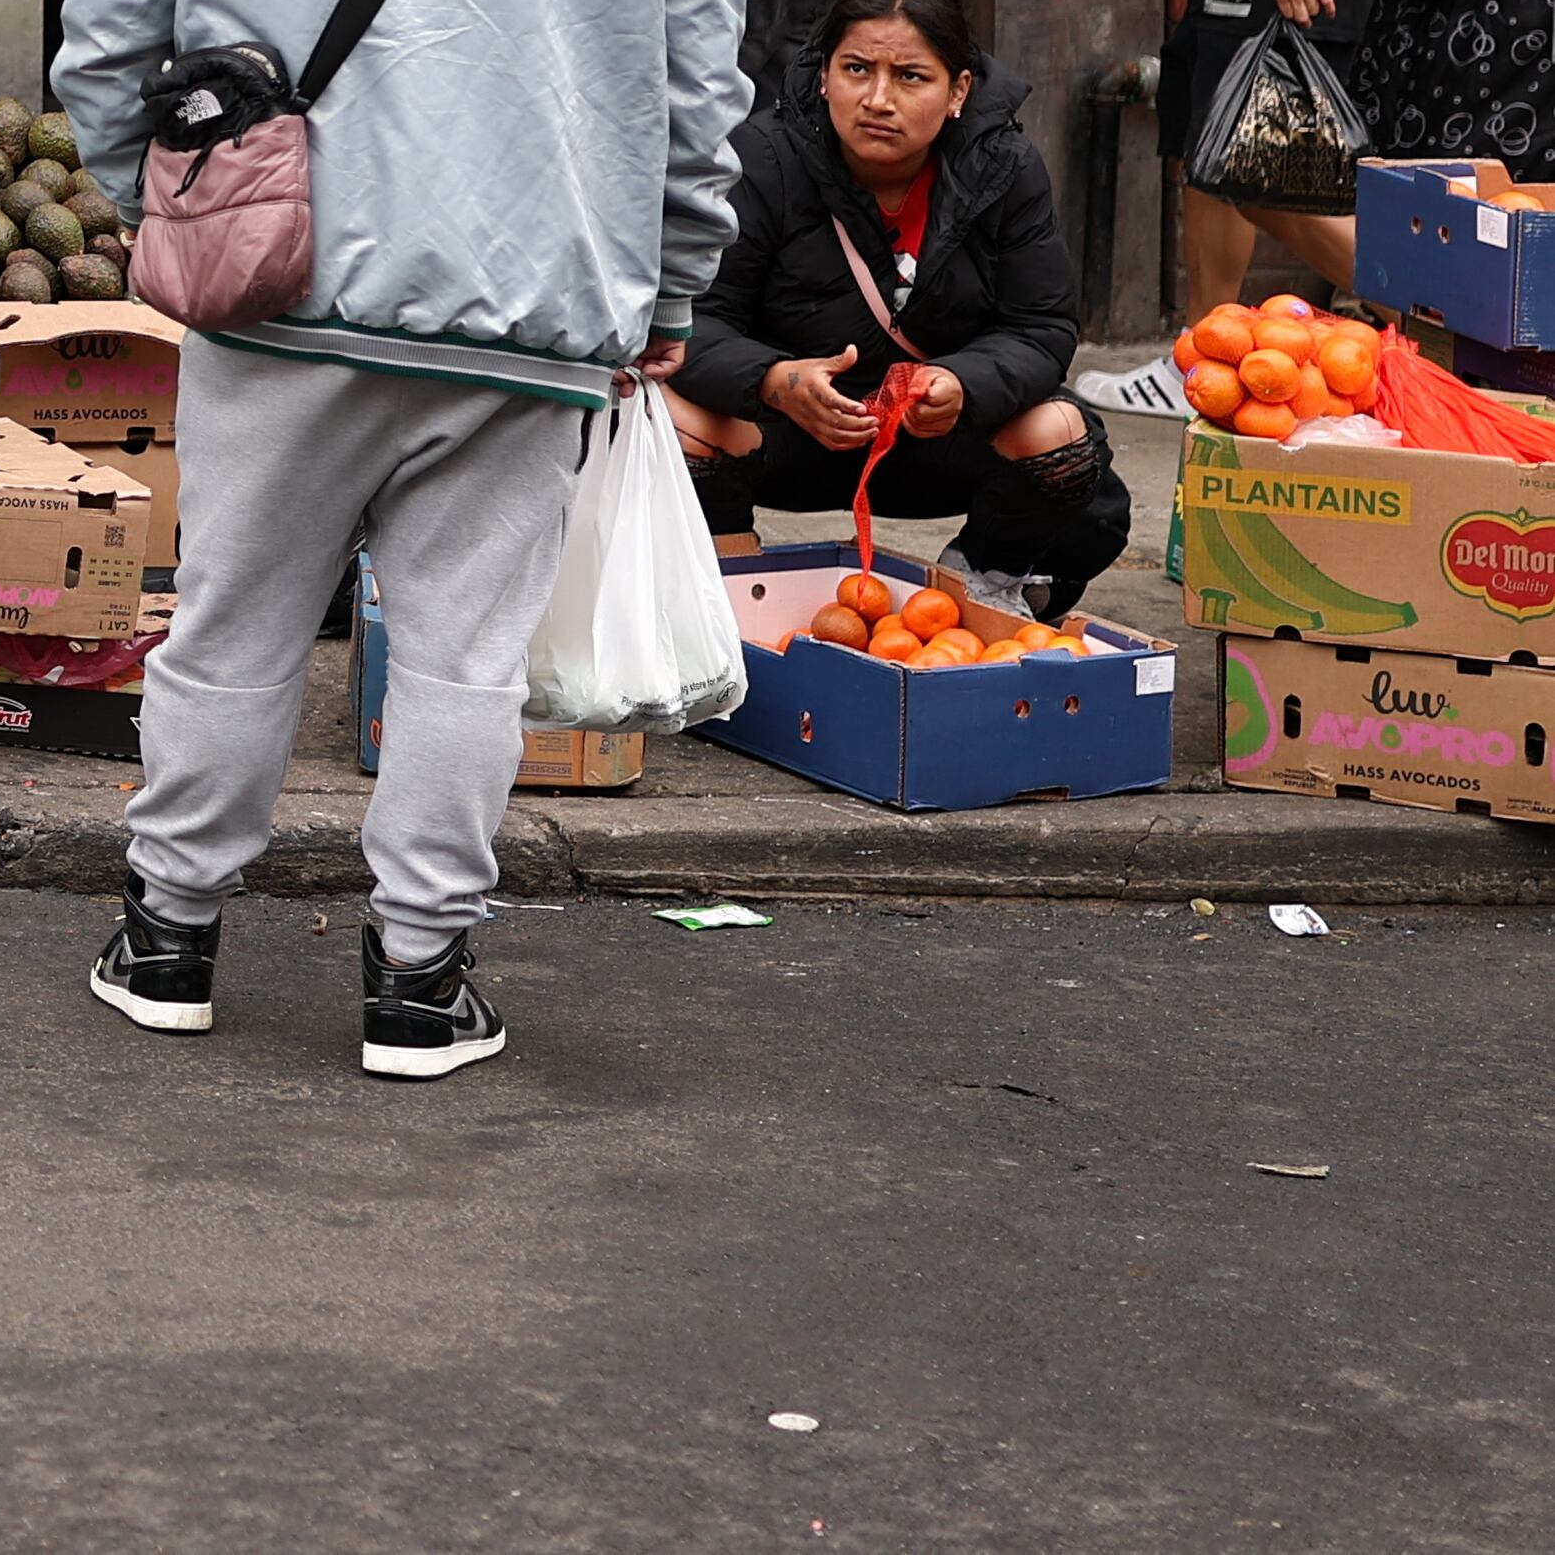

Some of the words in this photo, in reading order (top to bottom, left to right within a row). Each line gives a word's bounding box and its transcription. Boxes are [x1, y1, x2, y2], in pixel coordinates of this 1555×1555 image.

[4, 362, 176, 395] AVOPRO
[34, 409, 69, 420] HASS
[71, 408, 148, 420] AVOCADOS
[38, 498, 69, 511] HASS
[1200, 474, 1402, 518] PLANTAINS
[1454, 539, 1496, 568] Del
[1490, 572, 1550, 597] Quality
[108, 620, 129, 632] CAT
[1362, 670, 1451, 719] luv
[1306, 711, 1517, 768] AVOPRO
[1343, 762, 1385, 780] HASS
[1389, 767, 1482, 792] AVOCADOS
